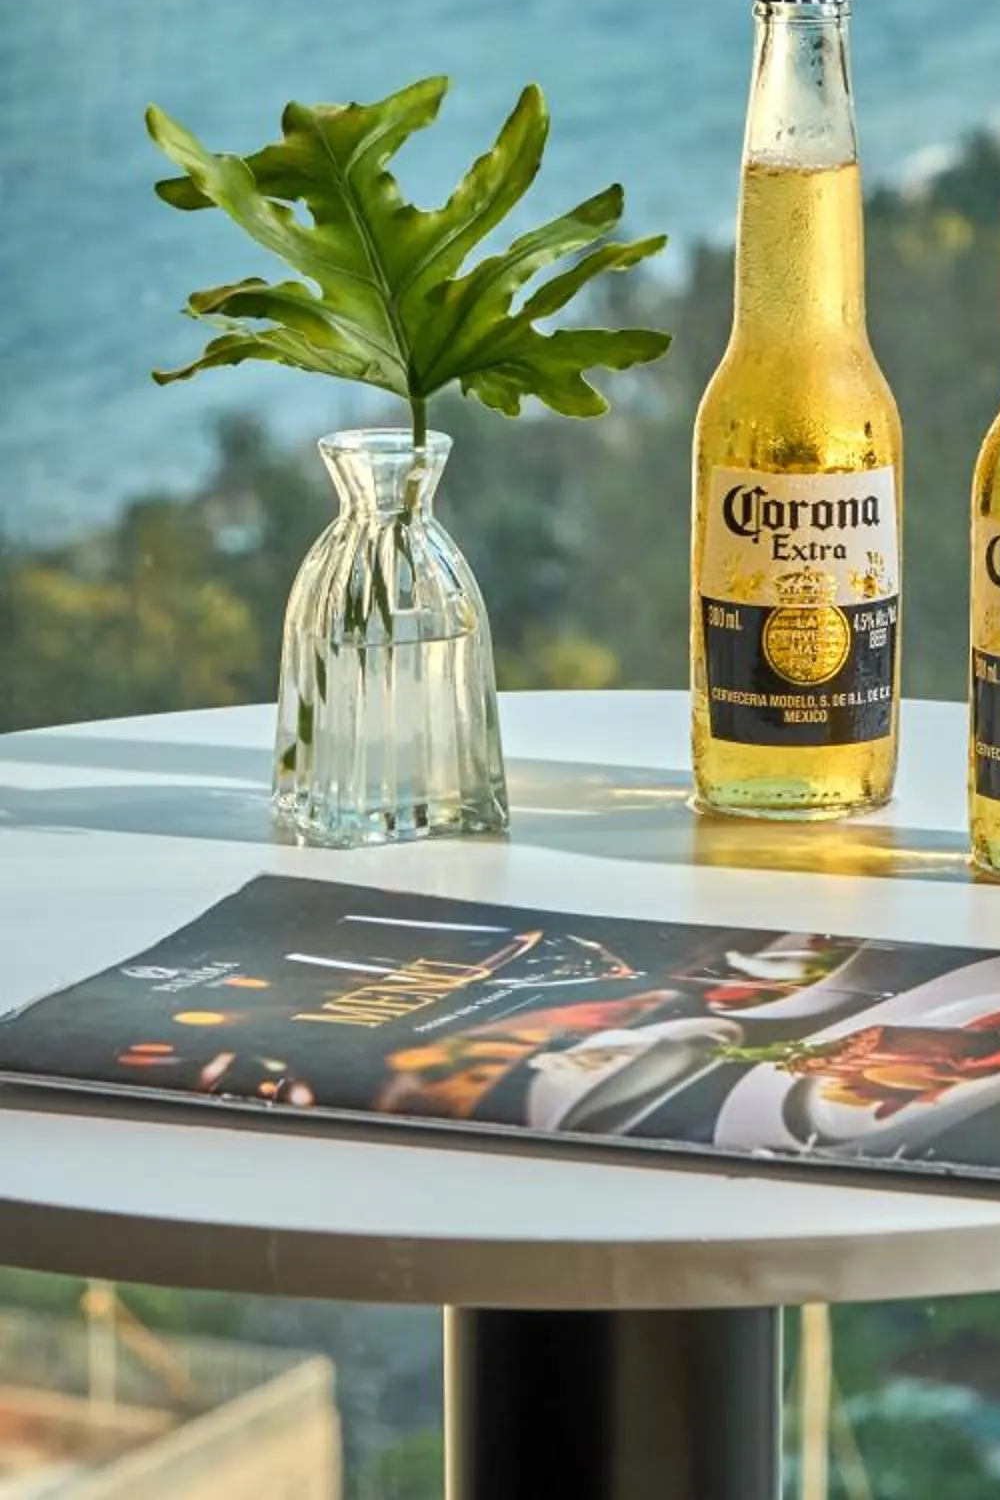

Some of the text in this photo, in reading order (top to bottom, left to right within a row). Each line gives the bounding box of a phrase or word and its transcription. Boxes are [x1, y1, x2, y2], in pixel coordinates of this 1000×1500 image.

[722, 484, 881, 544] Corona
[771, 534, 848, 562] Extra
[783, 709, 828, 724] MEXICO
[290, 957, 492, 1029] MENU
